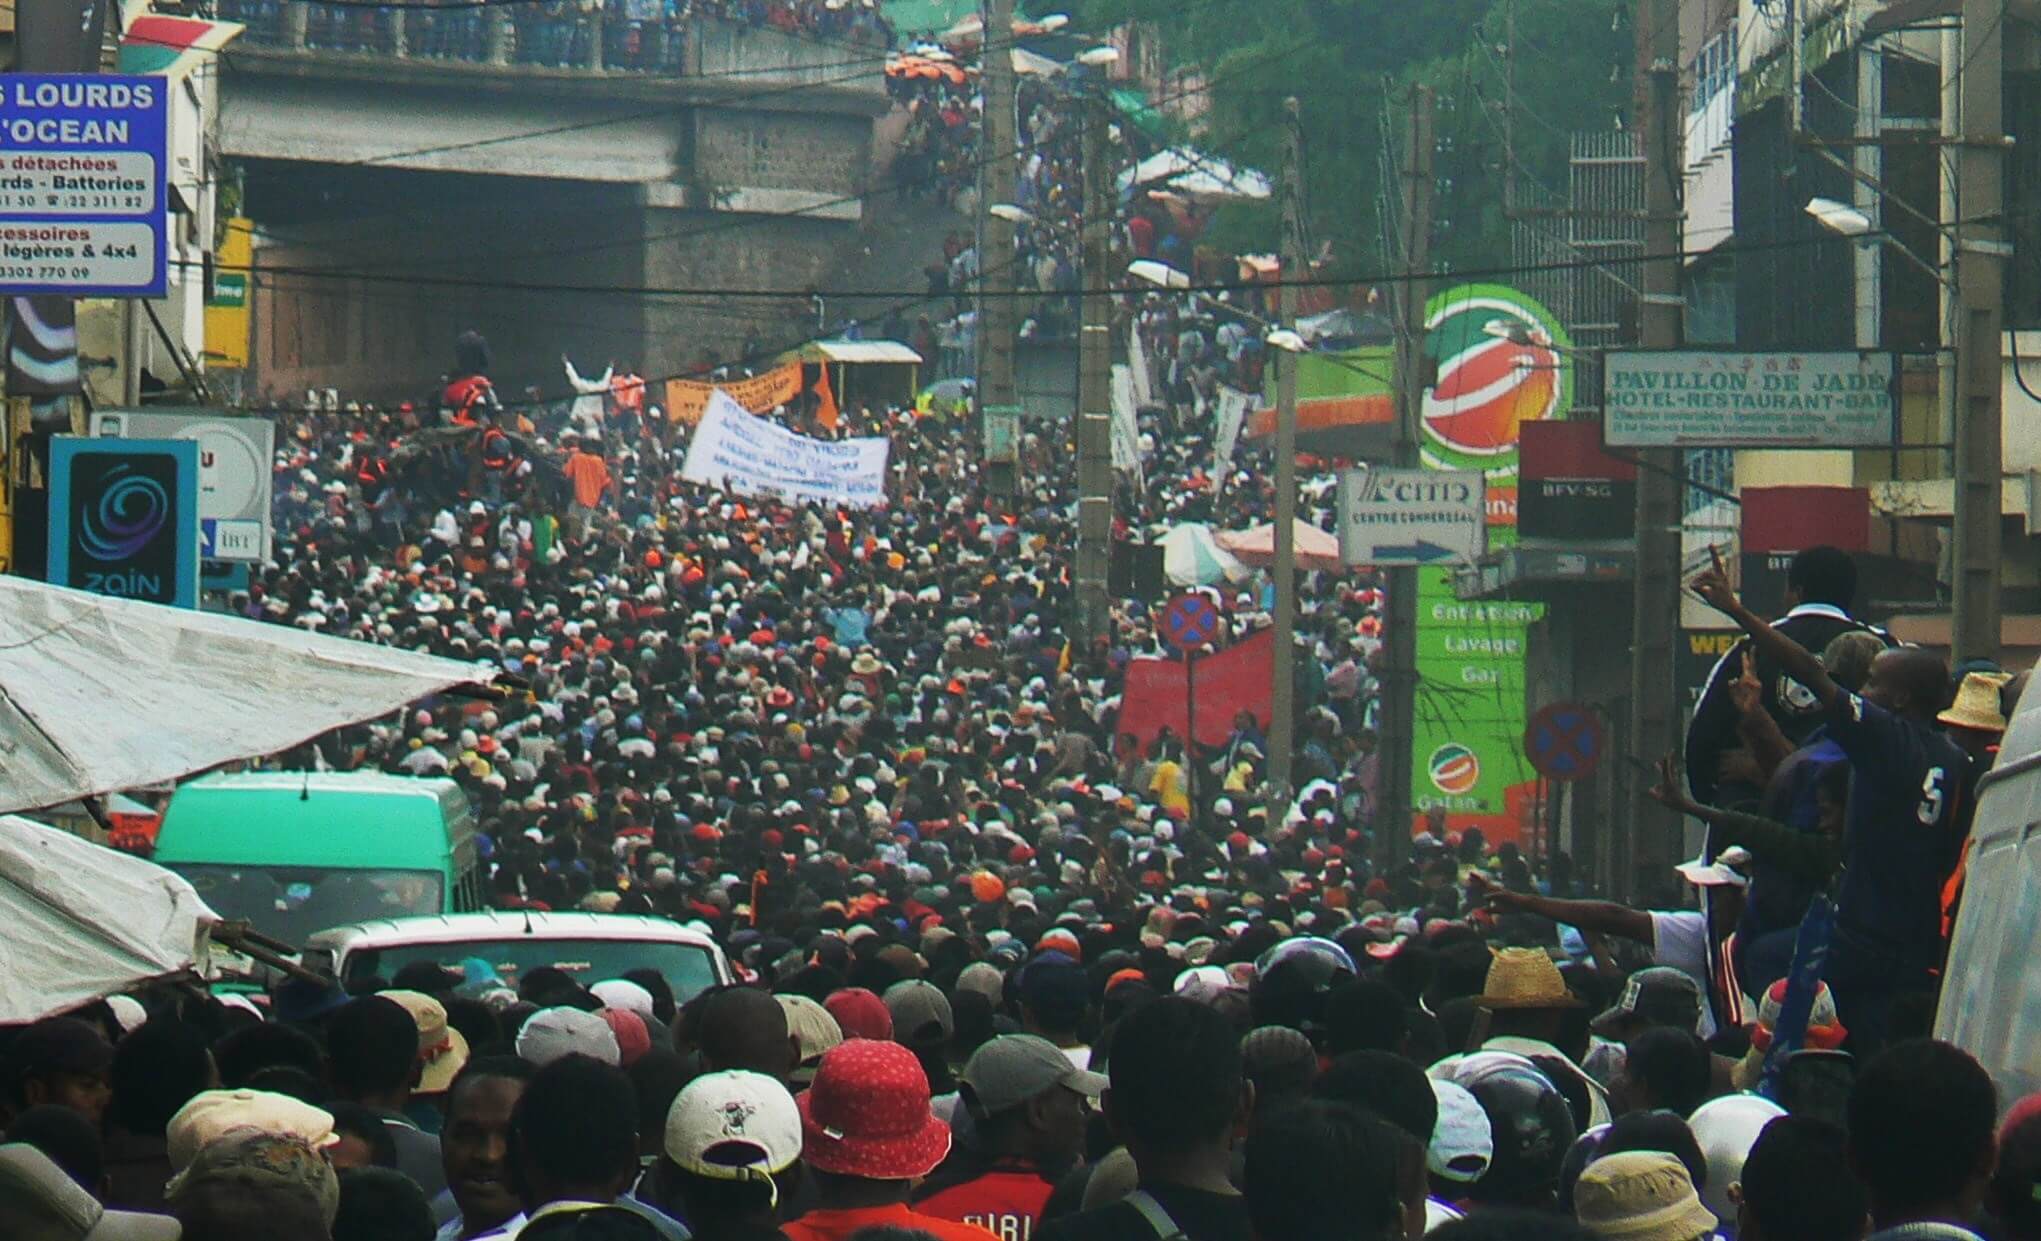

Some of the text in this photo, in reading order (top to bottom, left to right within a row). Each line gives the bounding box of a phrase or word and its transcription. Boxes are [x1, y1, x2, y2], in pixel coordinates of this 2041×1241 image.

[15, 82, 153, 108] LOURDS
[0, 118, 129, 144] 'OCEAN
[12, 155, 118, 171] détachées
[53, 175, 146, 191] Batteries
[0, 226, 90, 241] essoires
[102, 244, 137, 259] 4x4
[1612, 371, 1748, 390] PAVILLON
[1763, 374, 1800, 391] DE
[1916, 766, 1945, 825] 5
